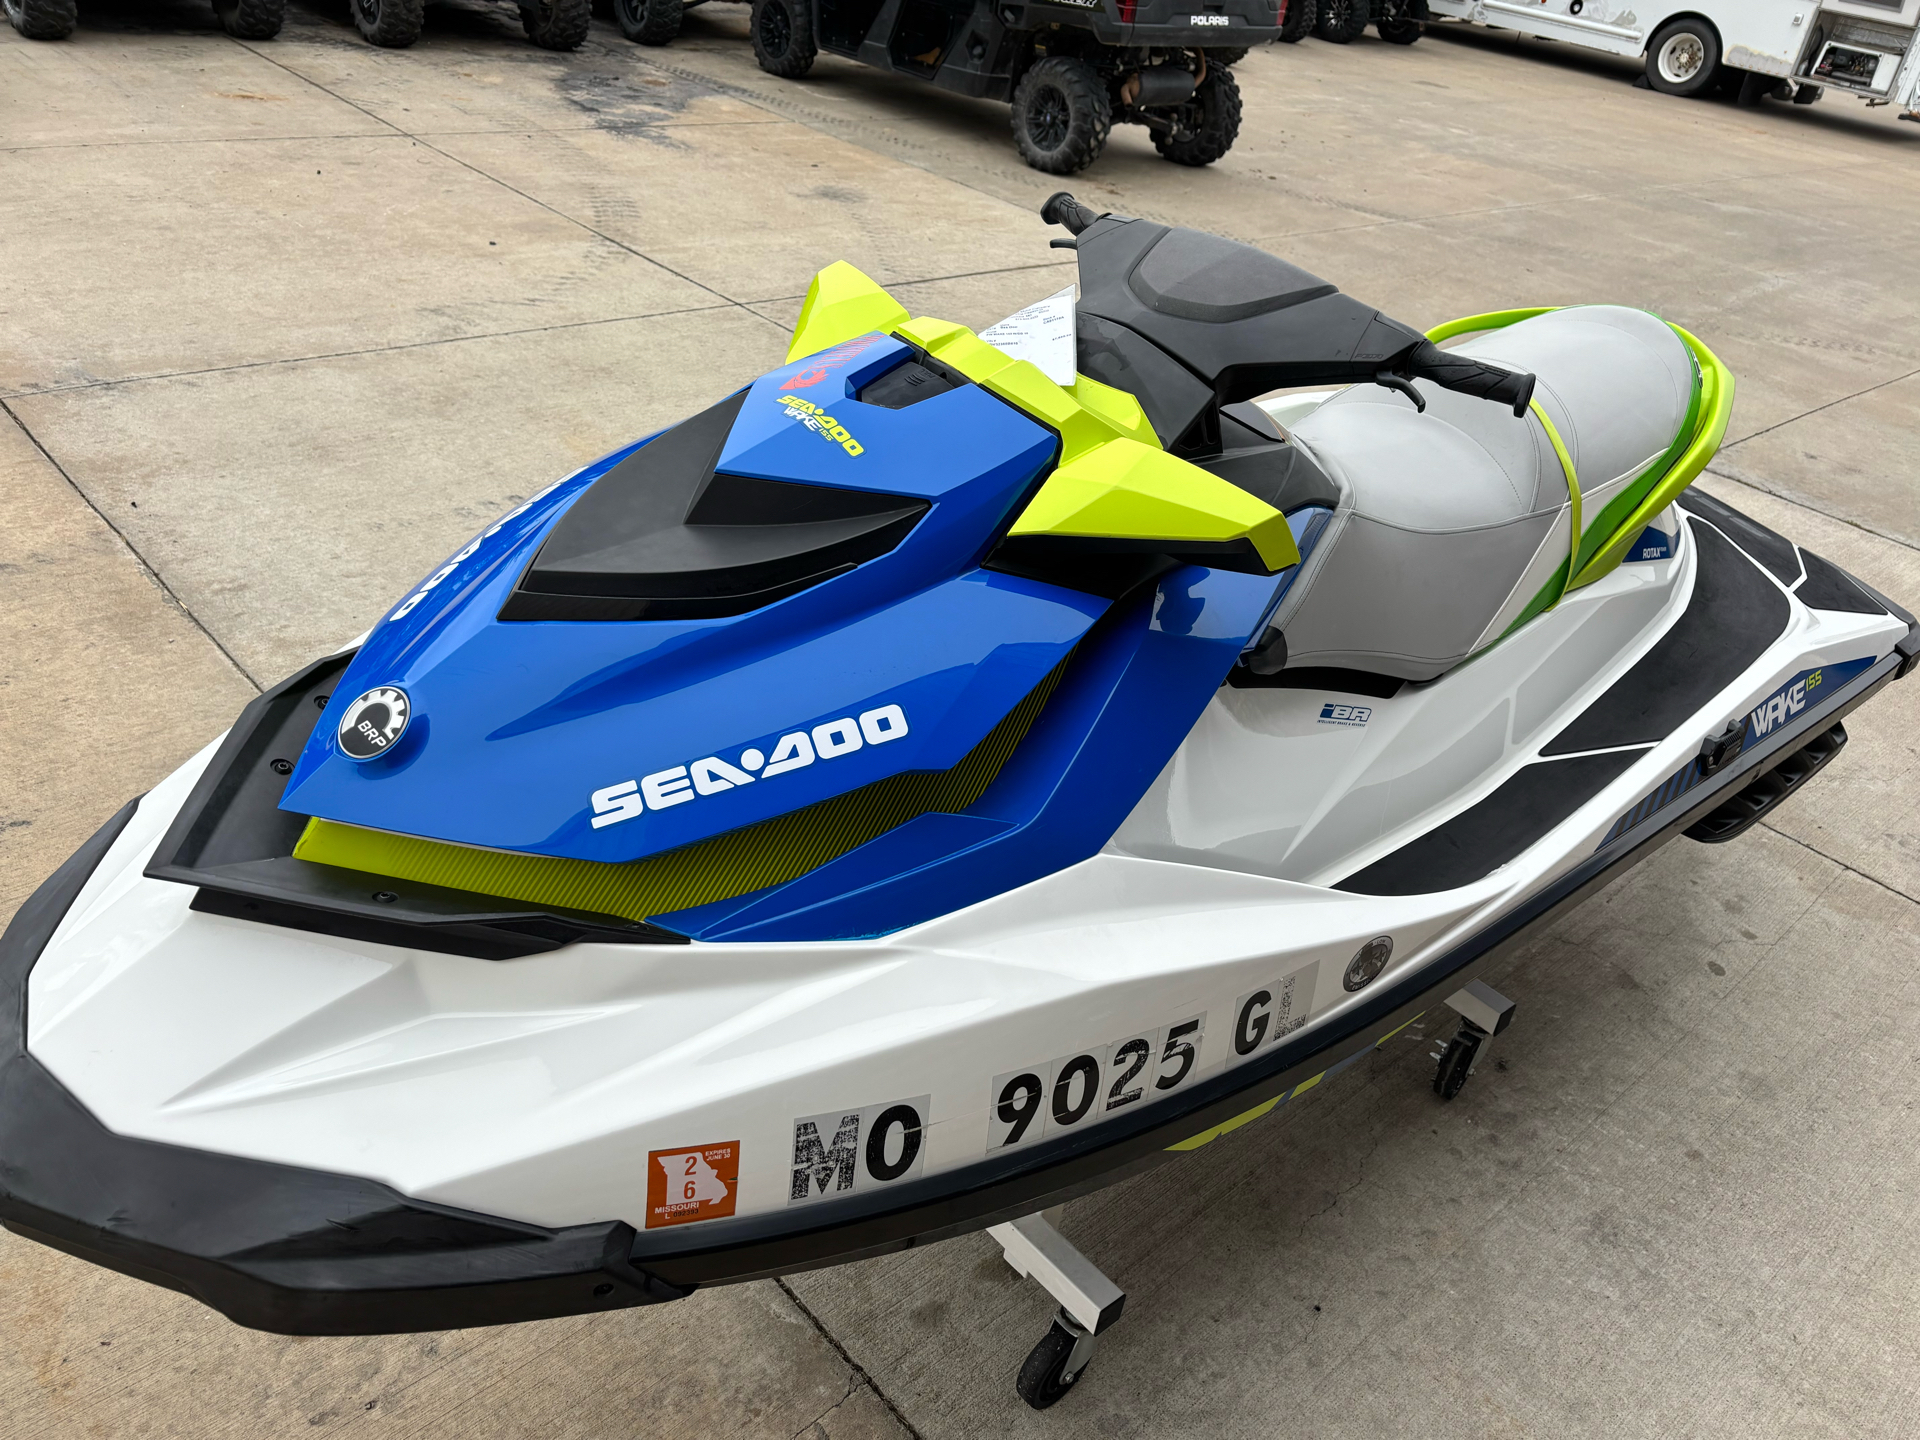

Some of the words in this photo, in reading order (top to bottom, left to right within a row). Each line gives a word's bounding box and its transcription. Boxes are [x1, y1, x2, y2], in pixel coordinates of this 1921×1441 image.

[1190, 15, 1229, 26] POLARIS
[783, 406, 822, 432] WAKE
[818, 426, 834, 441] 155
[1642, 547, 1660, 559] ROTAX
[1751, 679, 1806, 738] WAKE
[1806, 669, 1822, 691] 155
[357, 720, 387, 747] BRP
[791, 1104, 922, 1200] MO
[997, 1018, 1200, 1147] 9025
[705, 1148, 731, 1157] EXPIRES
[684, 1156, 697, 1176] 2
[683, 1181, 696, 1200] 6
[655, 1202, 700, 1214] MISSOURI
